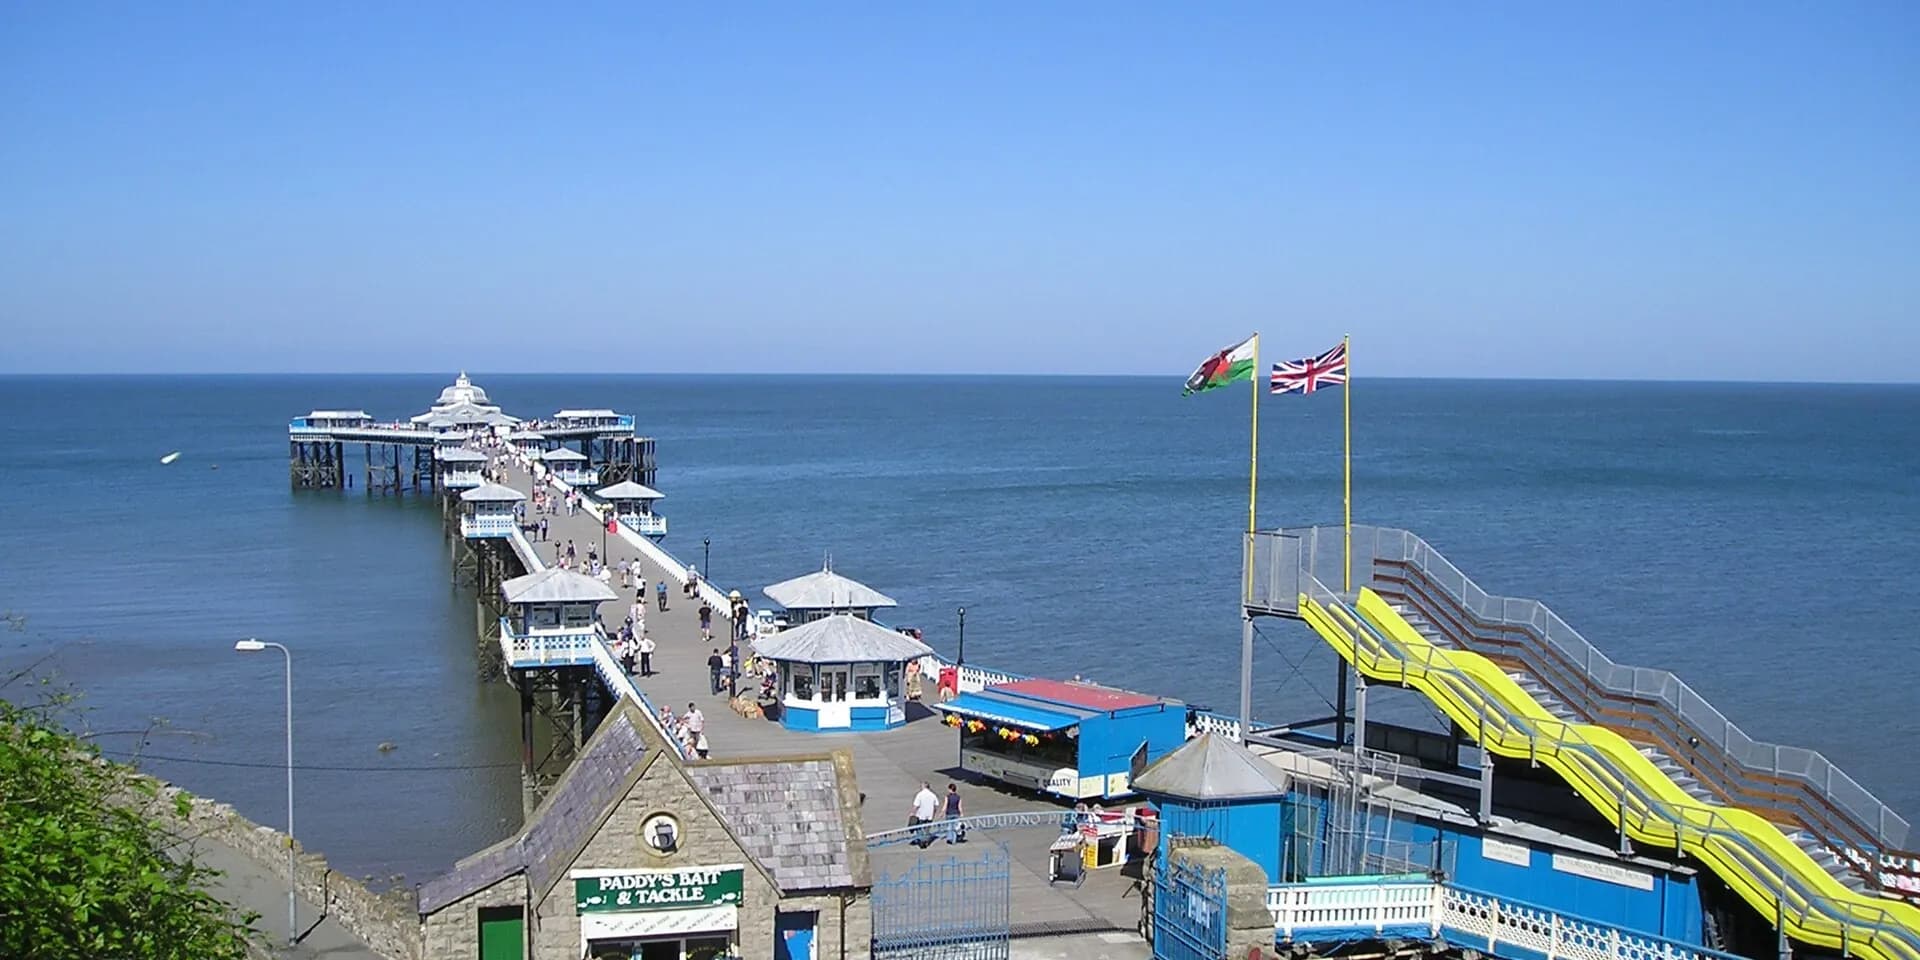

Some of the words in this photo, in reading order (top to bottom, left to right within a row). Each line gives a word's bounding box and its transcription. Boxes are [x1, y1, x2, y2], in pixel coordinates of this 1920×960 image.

[1048, 812, 1078, 825] PIER
[599, 873, 675, 890] PADDY'S
[679, 870, 721, 886] BAIT
[616, 891, 632, 905] &
[635, 887, 705, 904] TACKLE
